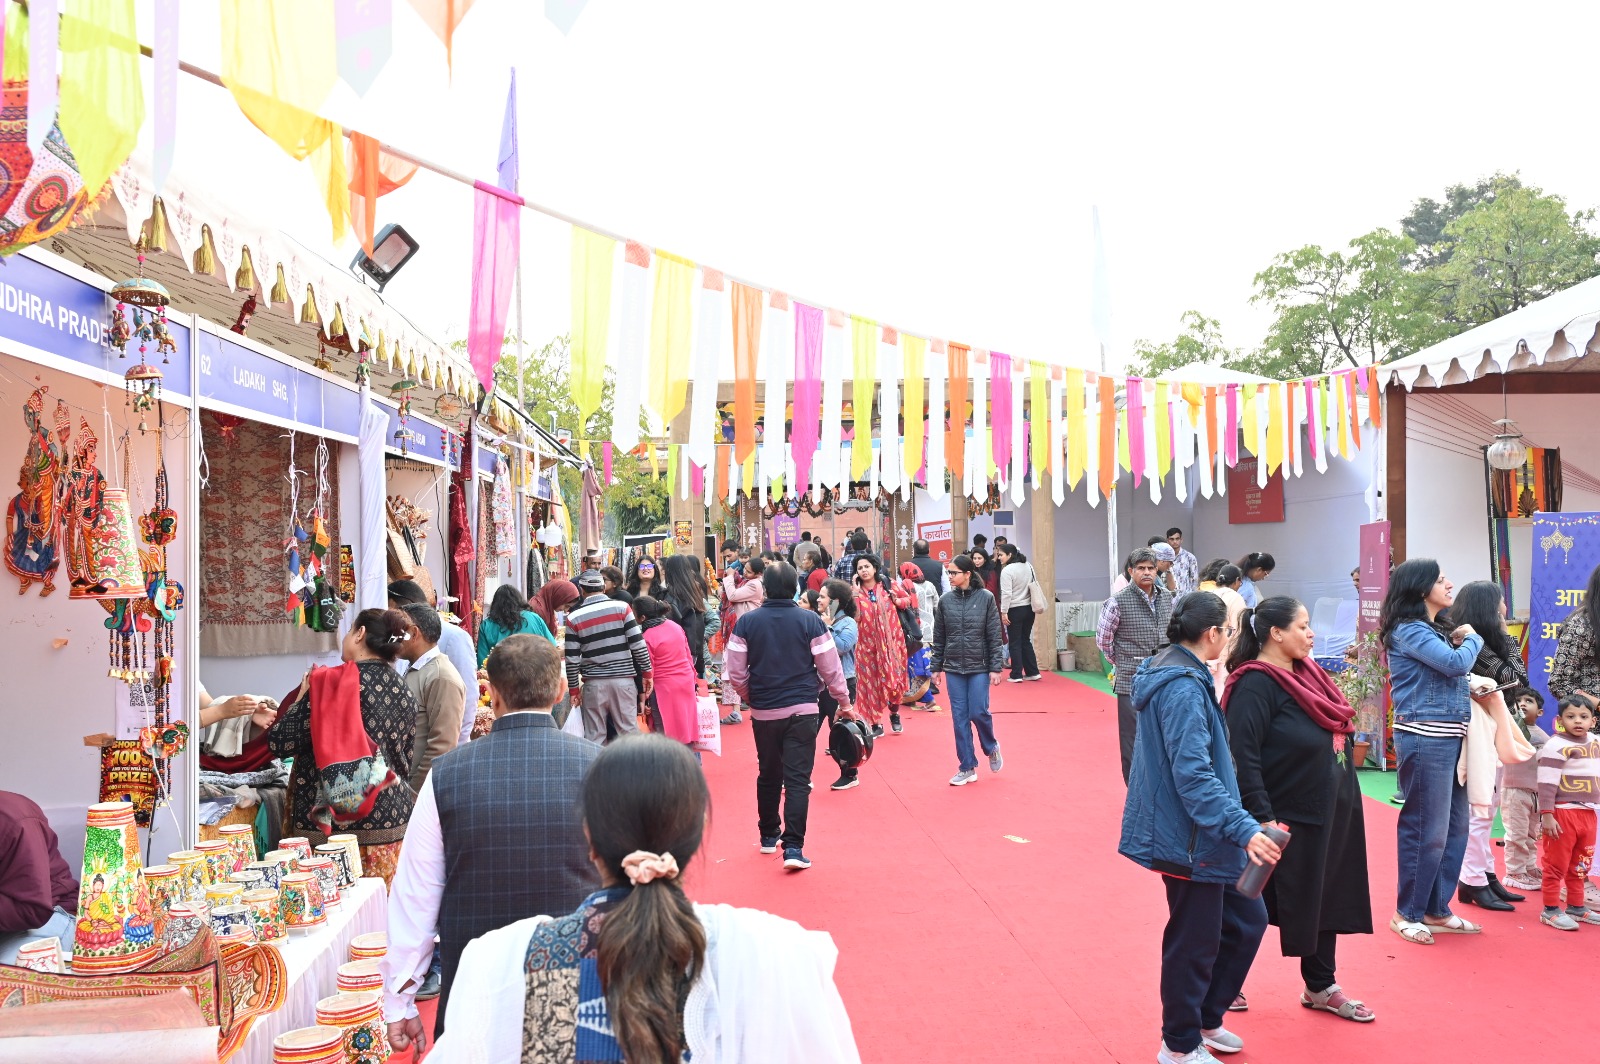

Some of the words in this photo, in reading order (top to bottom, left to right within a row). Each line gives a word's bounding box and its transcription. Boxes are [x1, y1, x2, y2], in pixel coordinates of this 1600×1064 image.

[201, 354, 212, 376] 62
[233, 365, 266, 393] LADAKH
[112, 741, 136, 749] SHOP
[109, 771, 152, 784] PRIZE!
